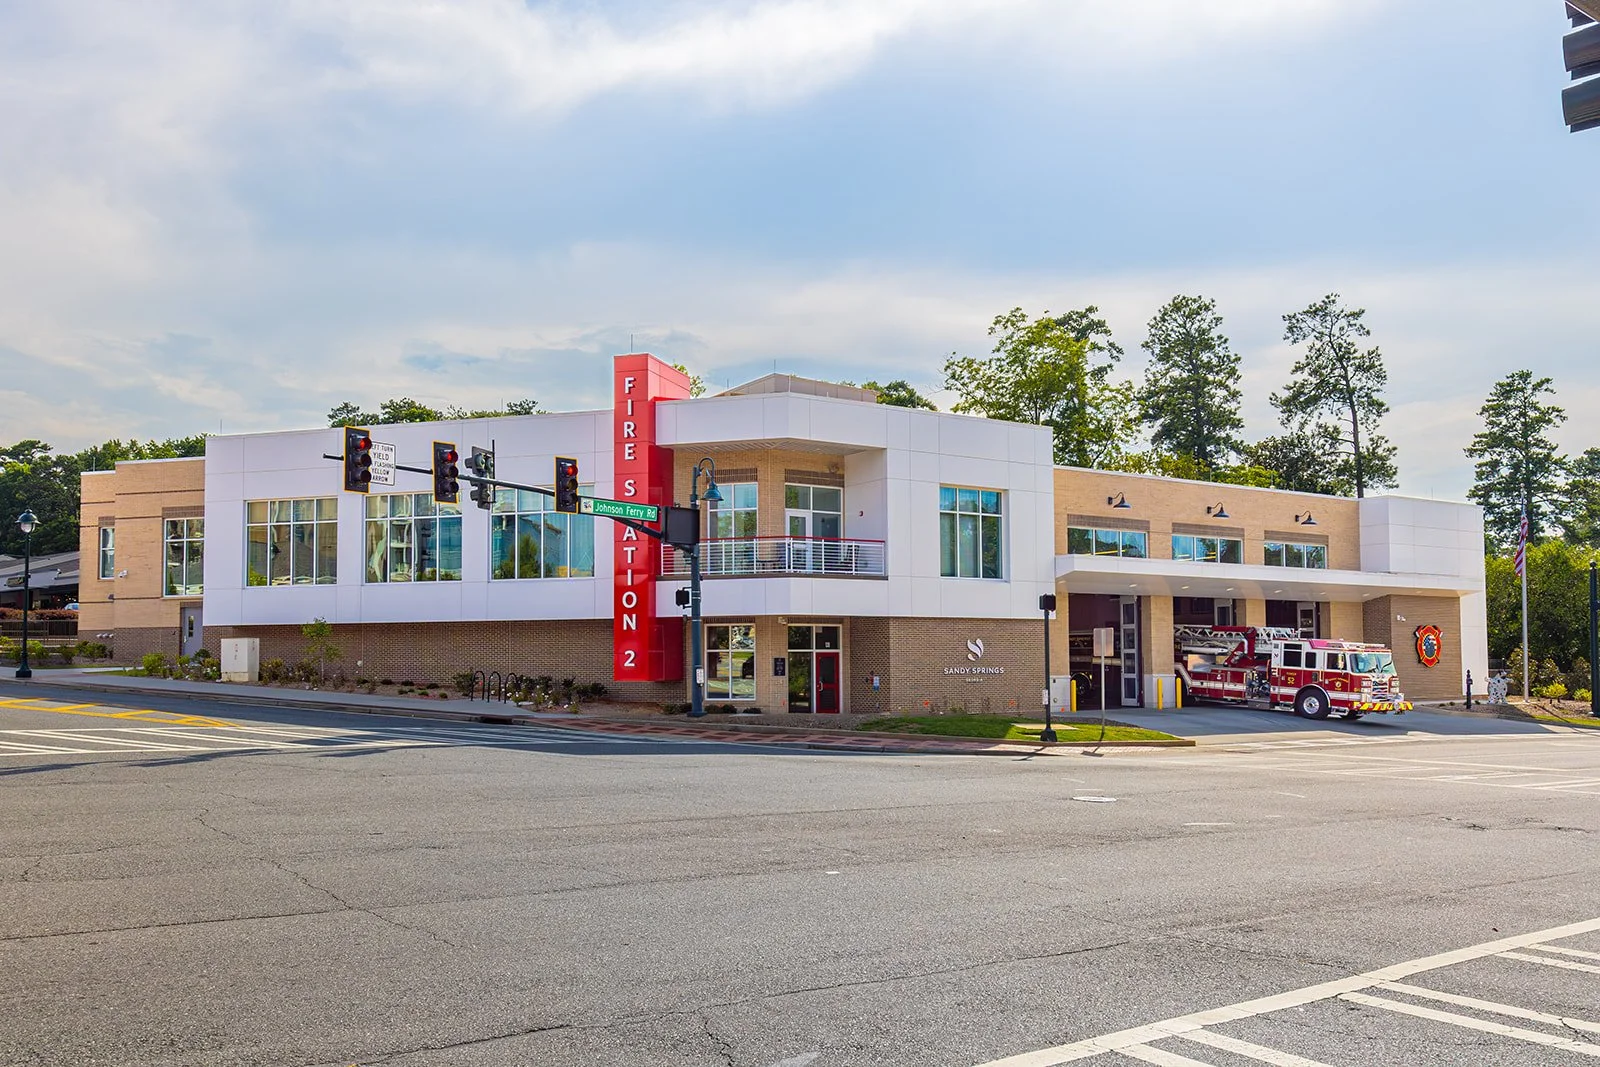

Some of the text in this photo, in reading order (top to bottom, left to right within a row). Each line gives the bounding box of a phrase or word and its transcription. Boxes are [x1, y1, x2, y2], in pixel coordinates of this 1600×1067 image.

[373, 452, 389, 460] YIELD
[595, 503, 656, 518] Johnson Ferry Rd
[622, 377, 638, 667] FIRE SATION 2
